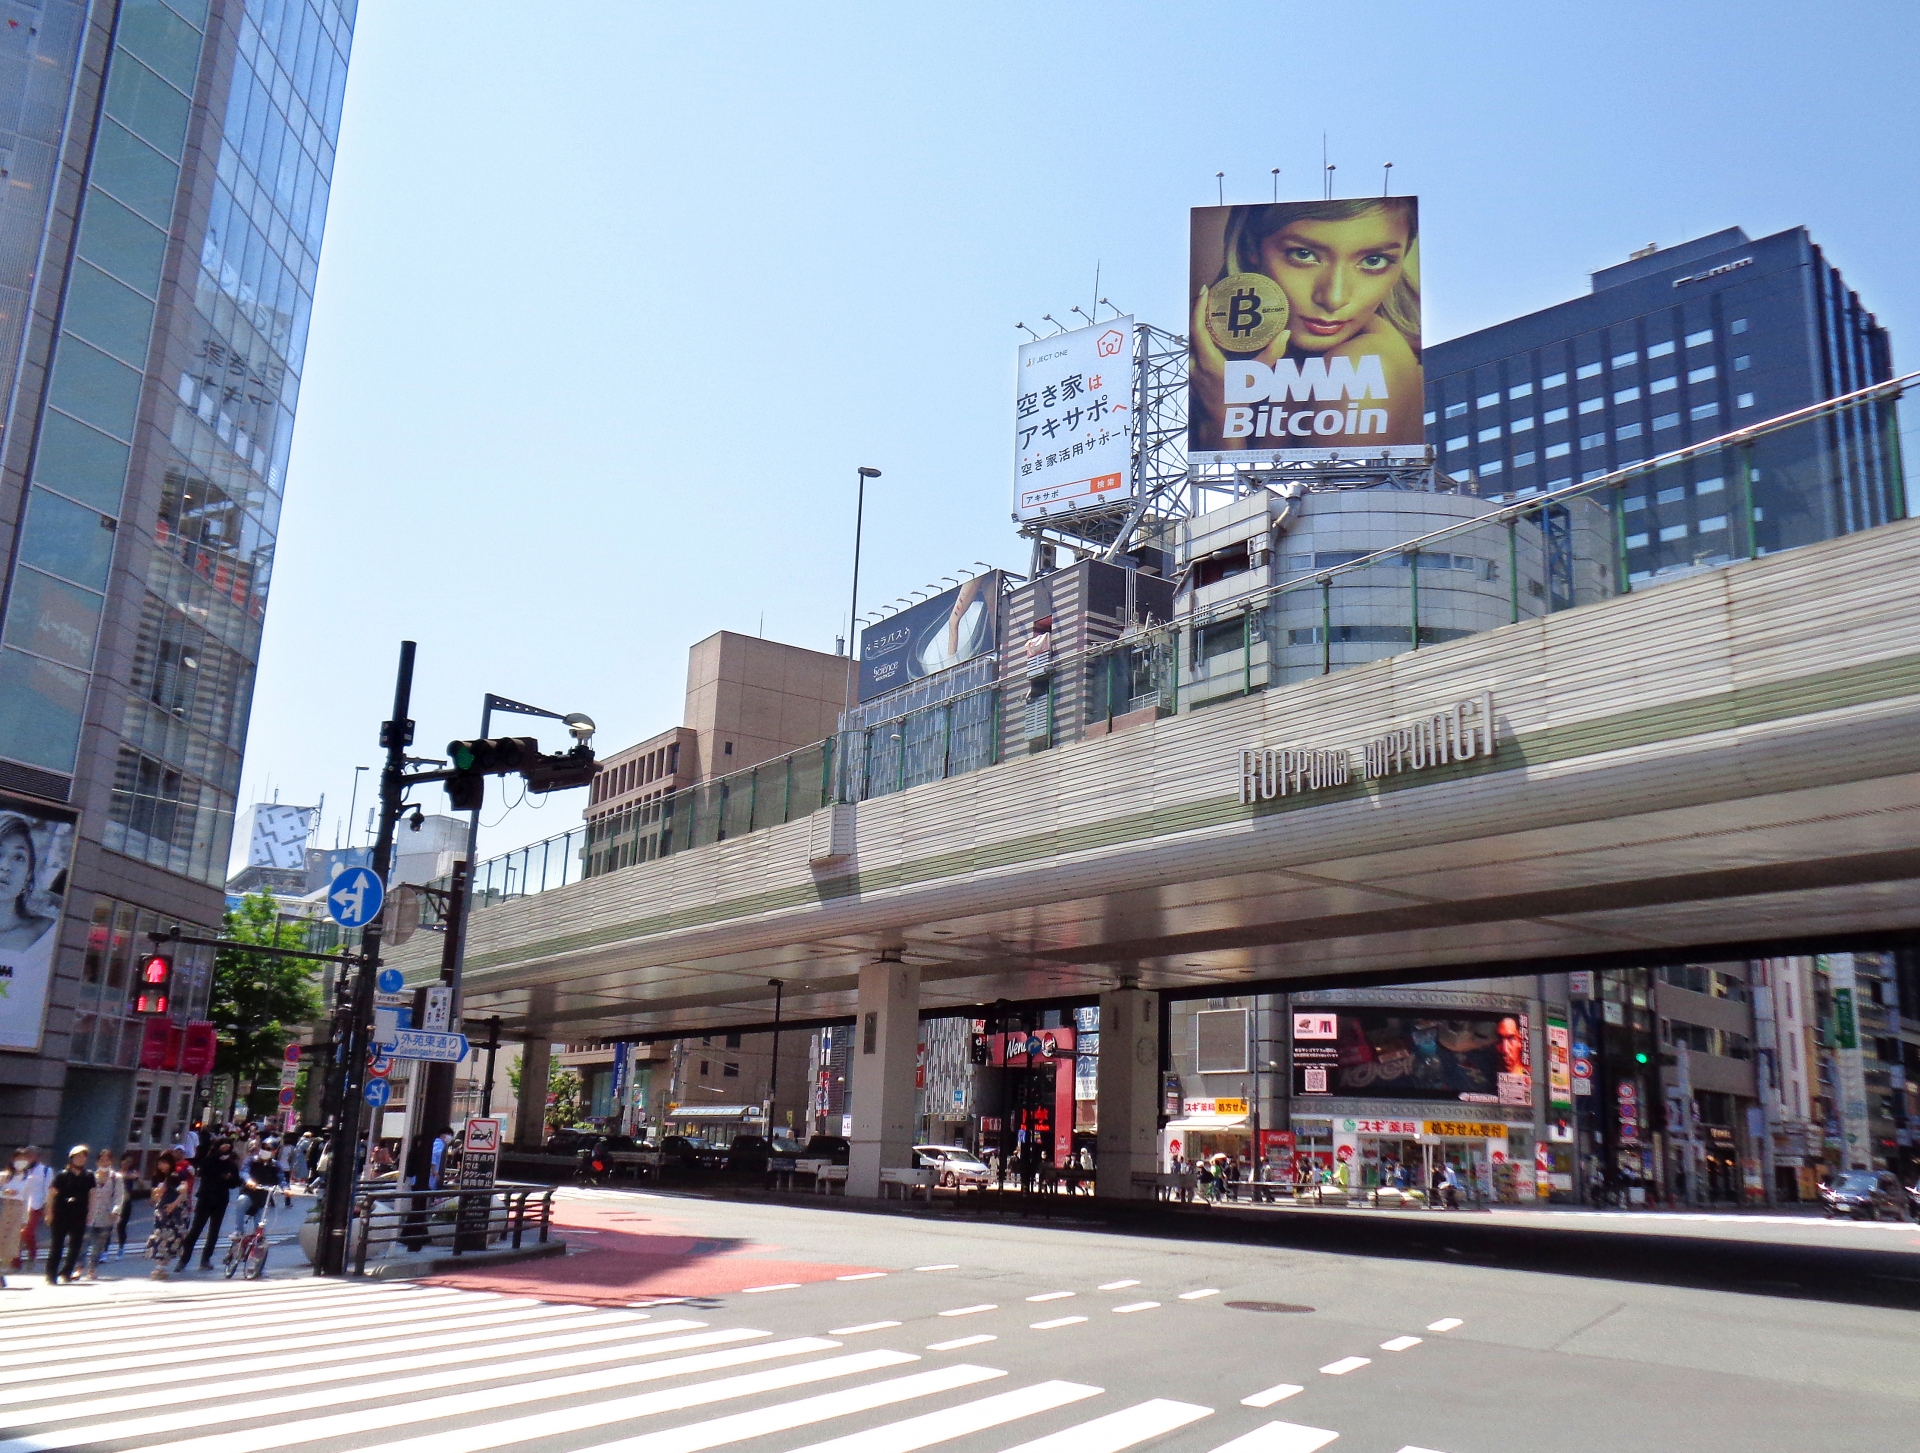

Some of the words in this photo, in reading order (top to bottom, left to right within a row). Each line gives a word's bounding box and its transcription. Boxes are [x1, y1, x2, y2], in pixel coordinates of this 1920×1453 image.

[1017, 373, 1103, 420] 空き家は
[1223, 354, 1389, 404] DMM
[1018, 395, 1128, 450] アキサポへ
[1222, 403, 1389, 439] Bitcoin
[1021, 424, 1131, 477] 空き家活用サポート
[1026, 490, 1060, 504] アキサポ
[1239, 749, 1349, 804] ROPPONGI
[1363, 690, 1495, 780] ROPPONGI
[400, 1033, 458, 1049] 外苑東通り
[1358, 1119, 1416, 1133] スギ薬局
